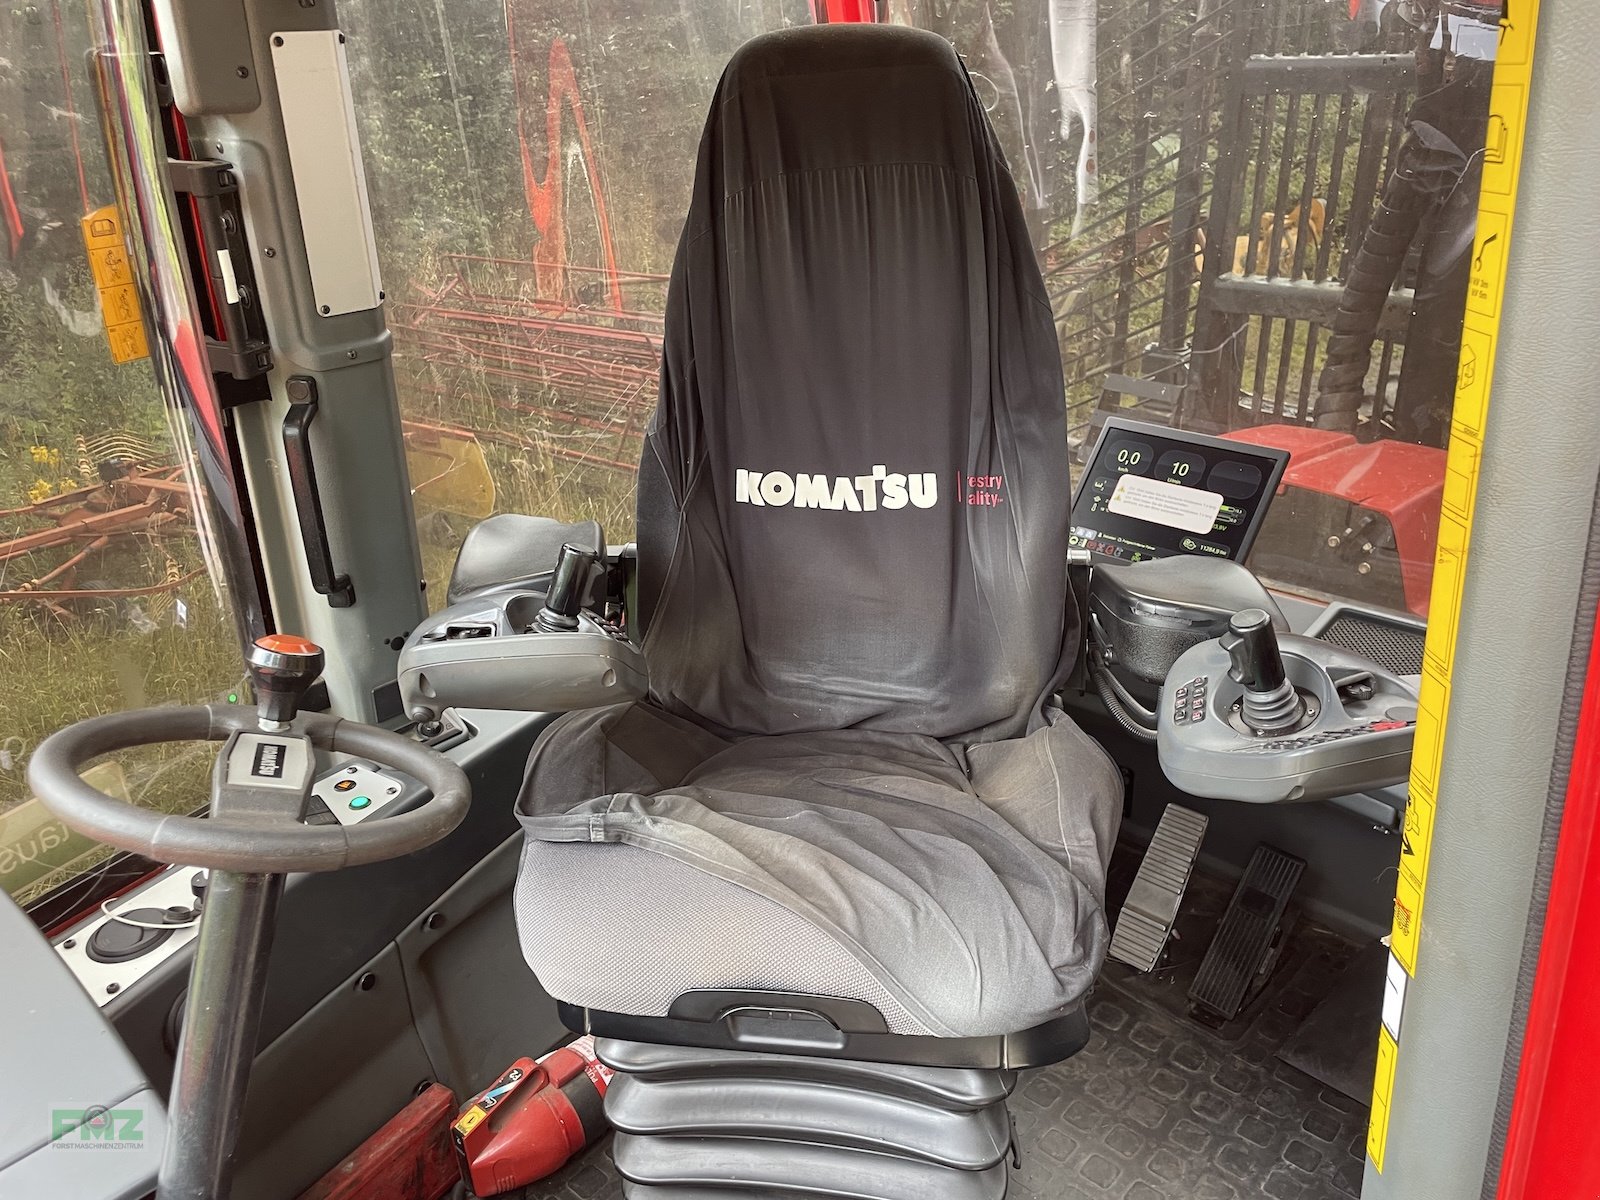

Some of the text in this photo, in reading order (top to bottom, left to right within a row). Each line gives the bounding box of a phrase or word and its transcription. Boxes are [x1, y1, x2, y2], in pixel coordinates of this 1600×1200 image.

[1117, 449, 1141, 465] 0,0
[1171, 461, 1190, 476] 10
[735, 464, 938, 512] KOMATSU
[967, 475, 1002, 489] estry
[258, 745, 280, 776] KOMATSU
